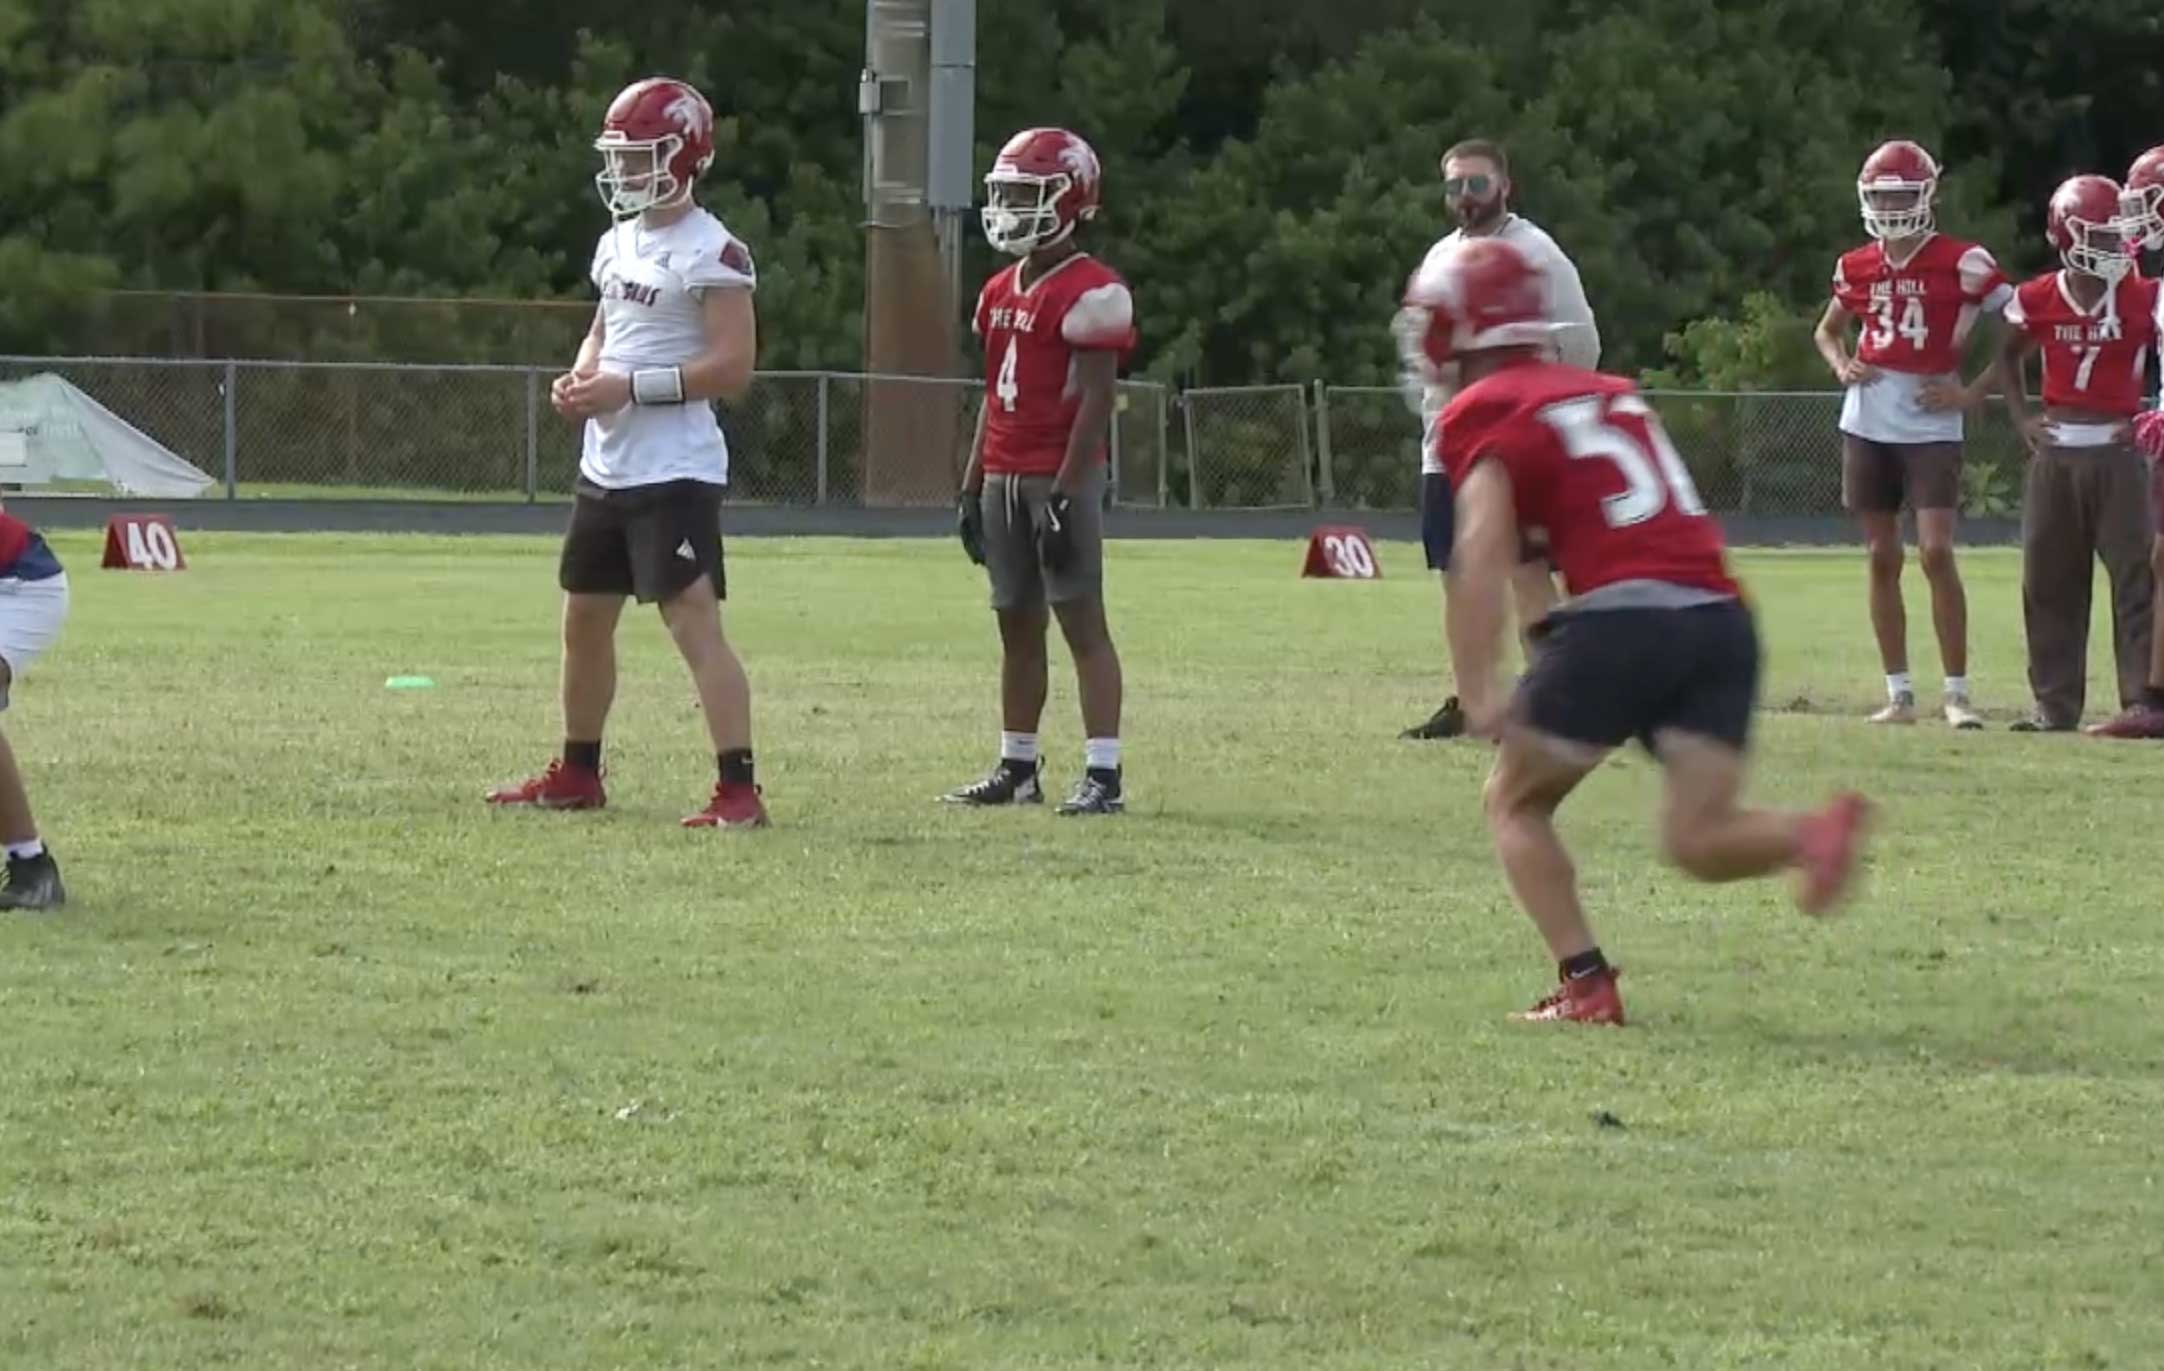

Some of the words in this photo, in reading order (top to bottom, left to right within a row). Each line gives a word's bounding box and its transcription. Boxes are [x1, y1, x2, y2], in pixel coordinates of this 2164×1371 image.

[1896, 279, 1927, 296] HILL
[1867, 296, 1929, 350] 34
[996, 334, 1018, 412] 4
[2069, 345, 2101, 392] 7
[127, 522, 177, 570] 40
[1325, 534, 1374, 578] 30
